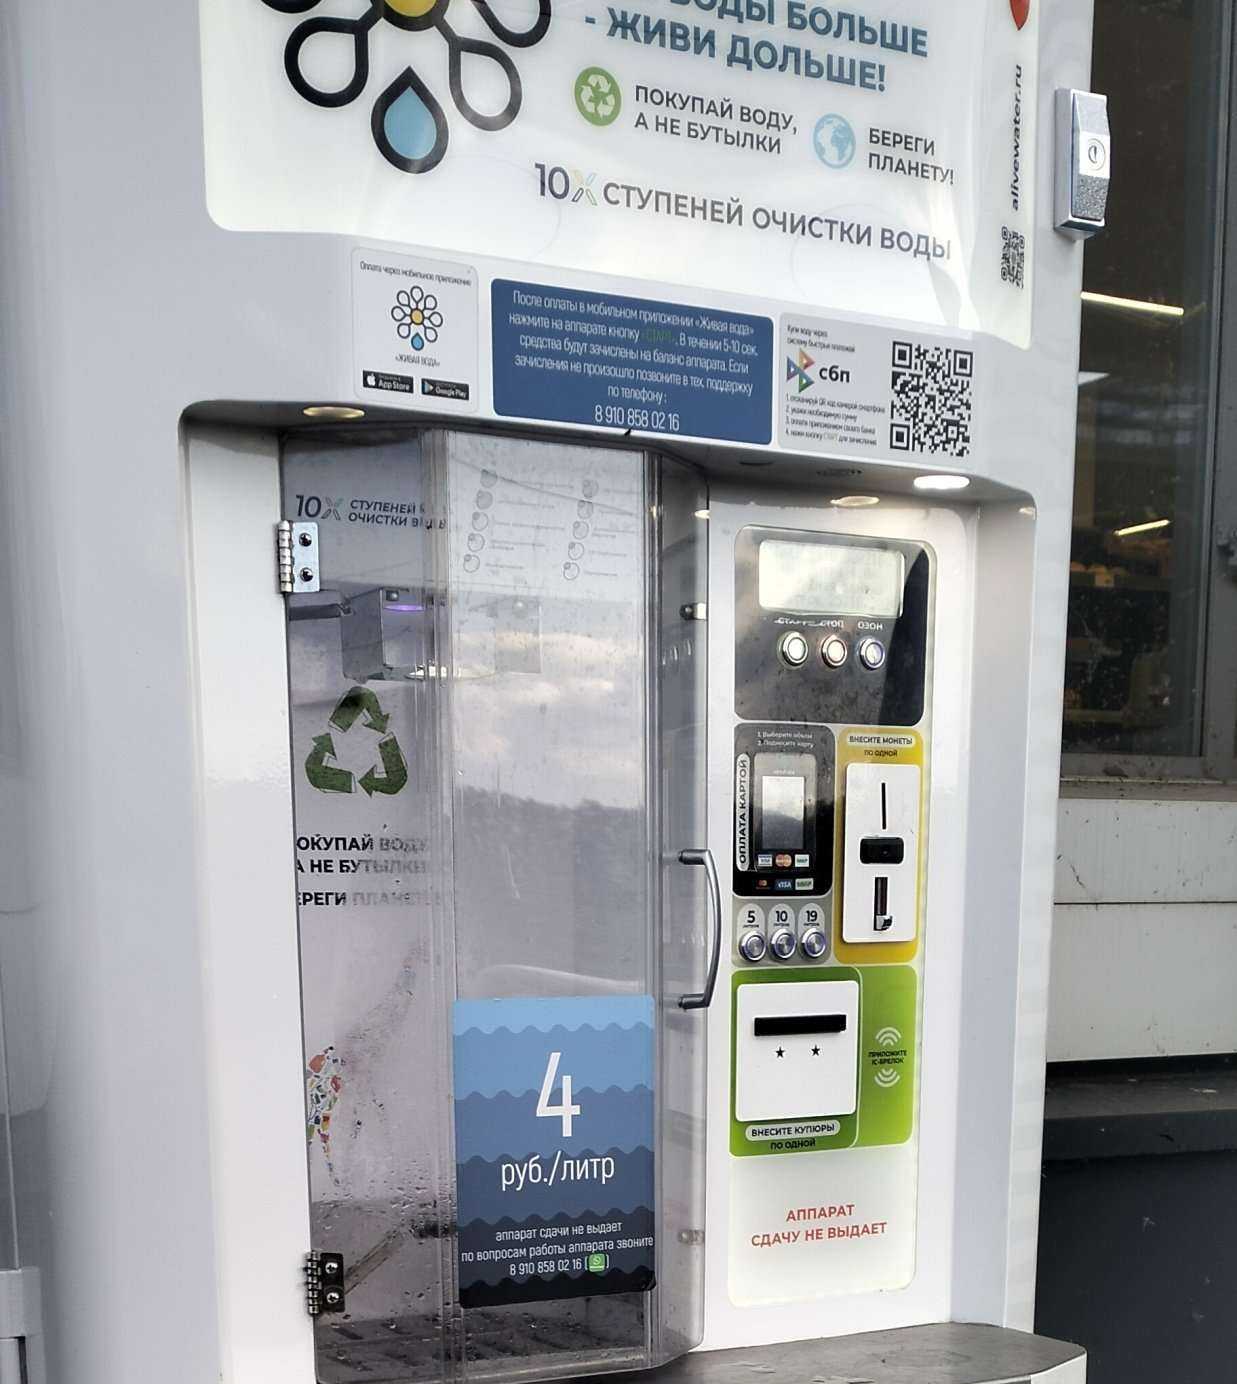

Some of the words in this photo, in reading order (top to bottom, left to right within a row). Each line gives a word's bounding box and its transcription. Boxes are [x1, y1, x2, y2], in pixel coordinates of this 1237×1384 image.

[670, 0, 774, 25] ДЫ
[787, 1, 928, 57] БОЛЬШЕ
[607, 8, 716, 58] ЖИВИ
[727, 34, 886, 92] ДОЛЬШЕ!
[635, 85, 734, 120] ПОКУПАЙ
[740, 106, 797, 135] ВОДУ,
[634, 111, 649, 130] А
[655, 115, 681, 136] НЕ
[687, 121, 781, 154] БУТЫЛКИ
[869, 127, 936, 156] БЕРЕГИ
[1011, 64, 1022, 211] alivewater.ru
[868, 152, 954, 185] ПЛАНЕТУ!
[603, 181, 743, 227] СТУПЕНЕЙ
[752, 207, 872, 247] ОЧИСТКИ
[880, 227, 951, 261] ВОДЫ
[513, 290, 542, 306] После
[544, 298, 577, 311] оплаты
[580, 303, 585, 312] в
[587, 302, 637, 320] мобильном
[640, 310, 694, 327] приложении
[695, 316, 728, 333] «Живая
[729, 323, 754, 336] вода»
[509, 312, 549, 329] нажмите
[552, 319, 563, 330] на
[565, 321, 606, 336] аппарате
[608, 326, 640, 343] кнопку
[687, 336, 722, 352] течении
[723, 338, 740, 352] 5-10
[519, 335, 562, 350] средства
[564, 337, 588, 356] будут
[590, 344, 639, 361] зачислены
[641, 350, 651, 360] на
[653, 348, 685, 366] баланс
[686, 356, 728, 372] аппарата.
[729, 359, 749, 374] Если
[514, 355, 569, 371] зачисления
[570, 361, 582, 372] не
[583, 362, 634, 379] произошло
[637, 368, 681, 385] позвоните
[683, 375, 688, 385] в
[706, 378, 754, 398] поддержку
[608, 385, 619, 397] по
[594, 404, 603, 423] 8
[605, 405, 624, 425] 910
[627, 408, 648, 427] 858
[652, 411, 665, 429] 02
[668, 414, 680, 431] 16
[349, 512, 407, 526] ОЧИСТКИ
[350, 499, 416, 515] СТУПЕНЕЙ
[857, 621, 882, 630] ОЗОН
[882, 737, 912, 745] МОНЕТЫ
[739, 759, 748, 810] КАРТОЙ
[739, 812, 747, 864] ОПЛАТА
[310, 859, 334, 873] НЕ
[339, 859, 426, 874] БУТЫЛКИ
[747, 910, 755, 923] 5
[776, 910, 788, 922] 10
[806, 910, 818, 922] 19
[536, 1051, 581, 1137] 4
[751, 1127, 793, 1137] ВНЕСИТЕ
[794, 1123, 835, 1134] КУПЮРЫ
[784, 1138, 816, 1149] ОДНОЙ
[501, 1150, 615, 1191] руб./литр
[786, 1204, 855, 1222] АППАРАТ
[496, 1229, 537, 1242] аппарат
[540, 1227, 569, 1239] сдачи
[572, 1225, 585, 1235] не
[587, 1222, 623, 1235] выдает
[751, 1231, 800, 1248] СДАЧУ
[805, 1229, 823, 1241] НЕ
[828, 1222, 887, 1239] ВЫДАЕТ
[461, 1251, 474, 1262] по
[477, 1248, 527, 1262] вопросам
[529, 1243, 566, 1259] работы
[569, 1240, 614, 1254] аппарата
[617, 1236, 654, 1249] звоните
[510, 1264, 516, 1275] 8
[519, 1262, 535, 1275] 910
[538, 1261, 555, 1273] 858
[558, 1259, 570, 1271] 02
[572, 1258, 582, 1270] 16
